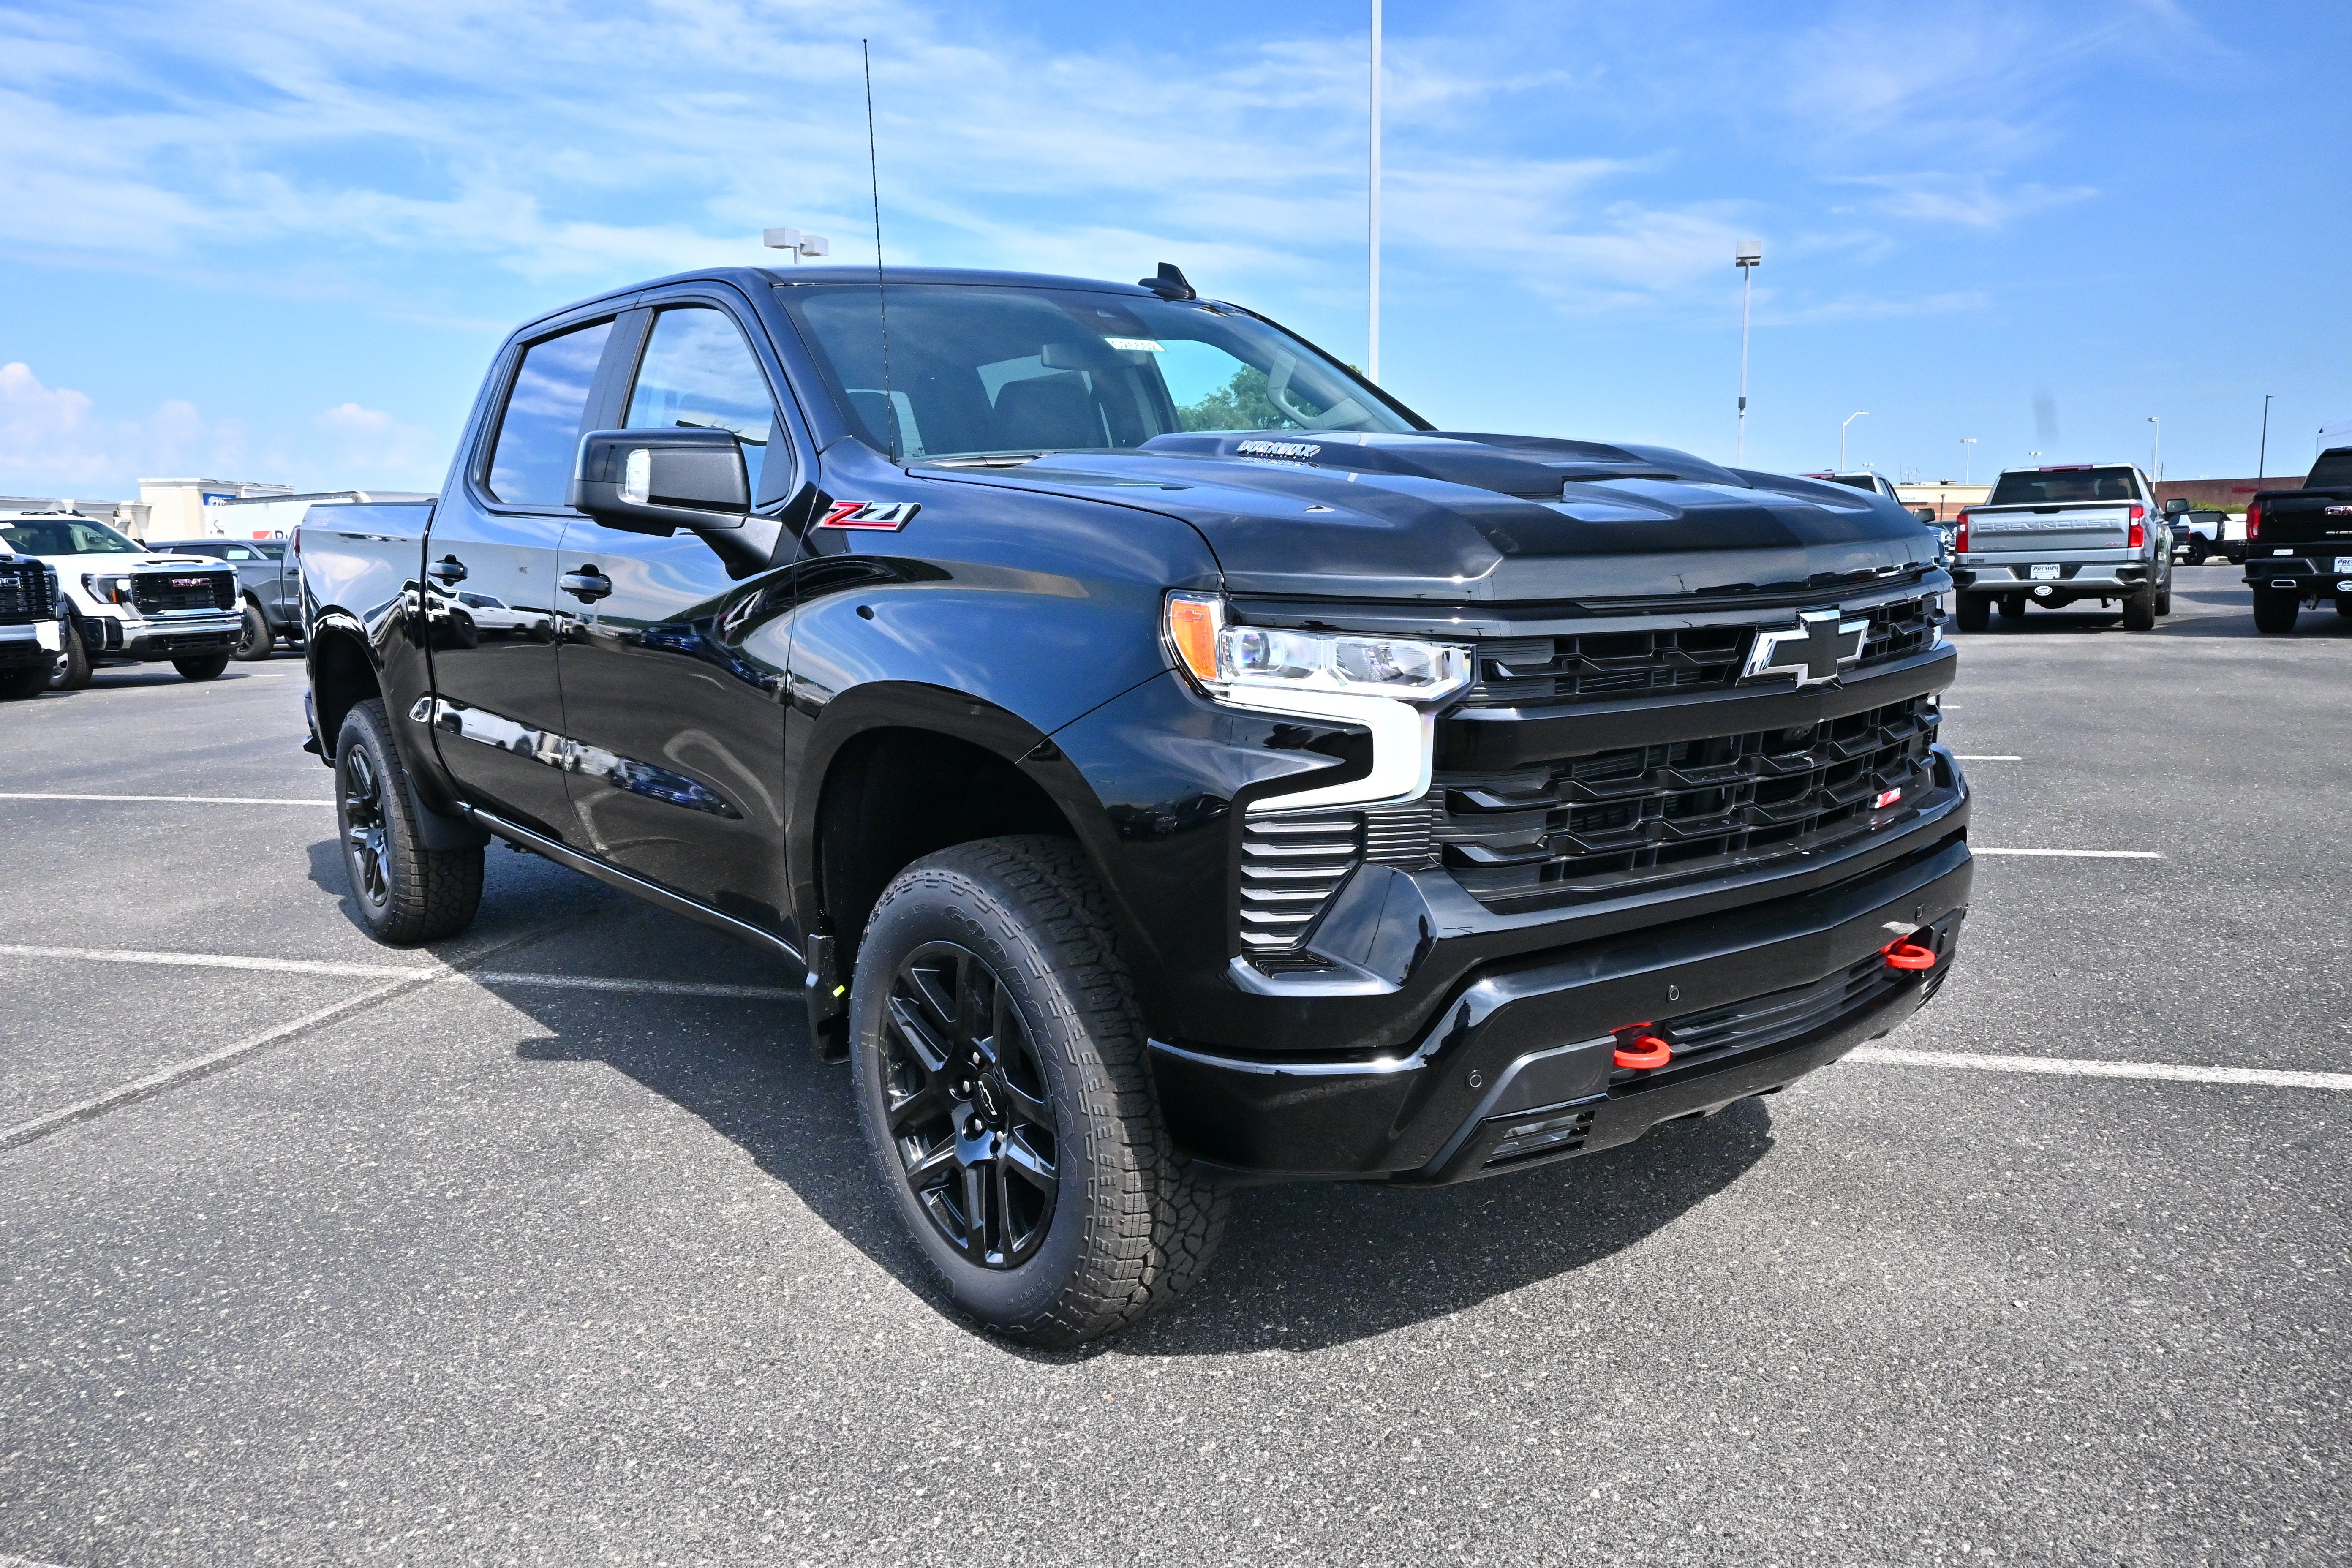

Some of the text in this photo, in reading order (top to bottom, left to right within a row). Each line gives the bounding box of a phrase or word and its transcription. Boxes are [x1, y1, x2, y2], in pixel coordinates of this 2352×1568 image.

[1236, 440, 1321, 458] DURAMAX
[817, 500, 922, 532] Z71
[1977, 519, 2117, 532] CHEVROLET
[172, 578, 210, 587] GMC
